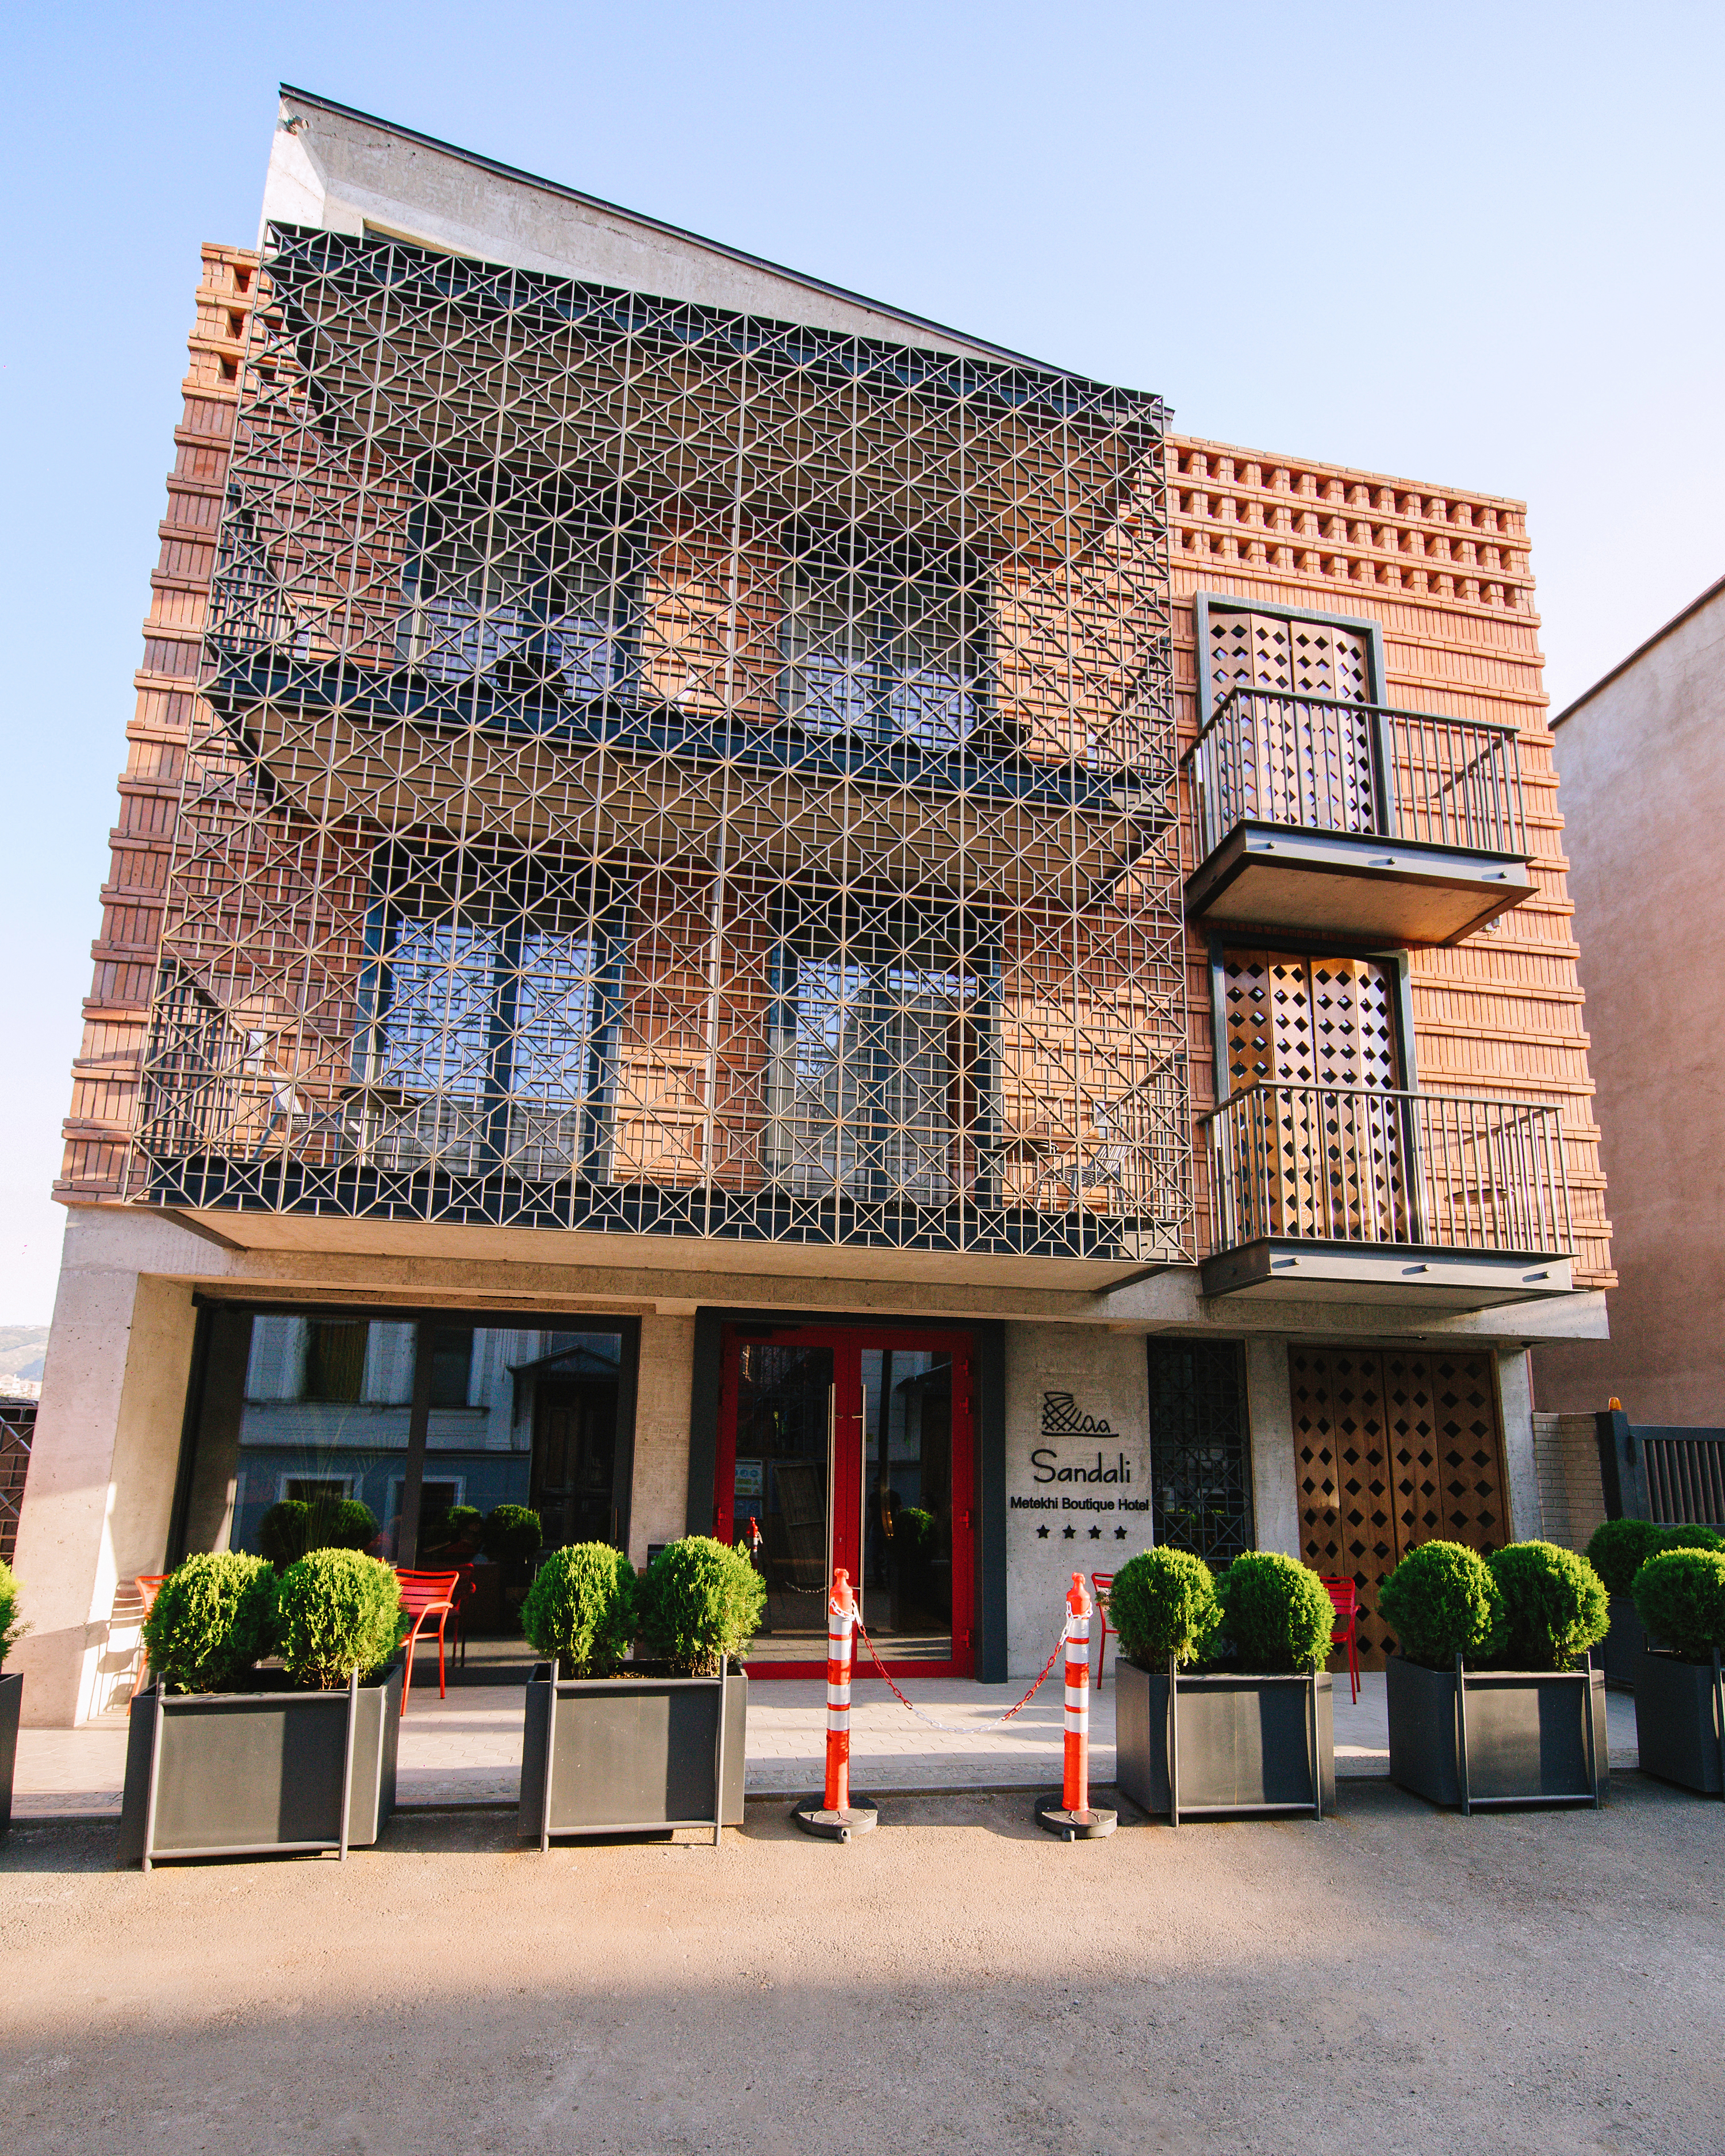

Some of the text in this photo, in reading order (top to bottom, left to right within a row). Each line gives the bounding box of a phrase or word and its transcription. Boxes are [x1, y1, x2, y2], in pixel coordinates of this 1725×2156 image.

[1031, 1449, 1130, 1483] Sandali
[1010, 1497, 1149, 1513] Metekhi Boutique Hotel
